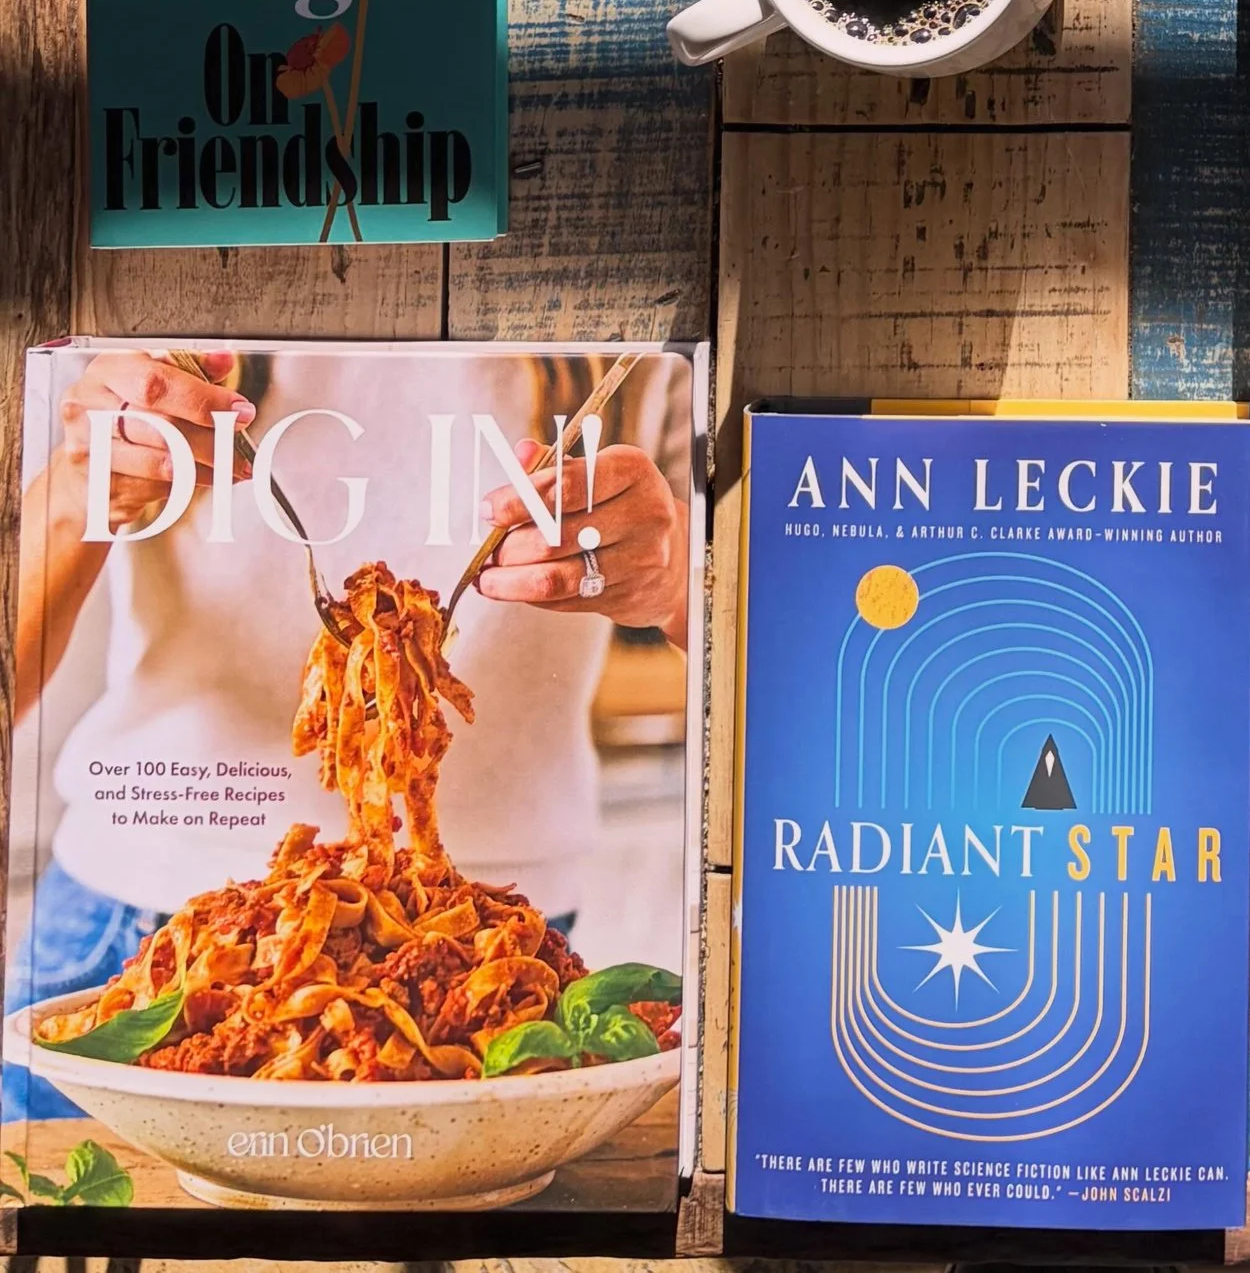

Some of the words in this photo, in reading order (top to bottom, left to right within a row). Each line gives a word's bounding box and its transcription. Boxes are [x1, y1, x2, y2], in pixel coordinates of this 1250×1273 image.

[204, 22, 290, 127] On
[103, 101, 472, 222] Friendship
[80, 409, 370, 547] DIG
[424, 412, 603, 550] IN!
[788, 455, 934, 510] ANN
[974, 458, 1219, 514] LECKIE
[89, 762, 131, 777] Over
[135, 761, 167, 777] 100
[170, 762, 211, 782] Easy,
[216, 762, 293, 780] Delicious,
[94, 786, 126, 801] and
[130, 786, 220, 802] Stress-Free
[224, 787, 286, 805] Recipes
[111, 812, 128, 825] to
[132, 810, 180, 826] Make
[184, 814, 204, 826] on
[209, 811, 266, 829] Repeat
[773, 818, 1044, 877] RADIANT
[1067, 823, 1222, 883] STAR
[808, 1157, 834, 1172] ARE
[839, 1158, 866, 1173] FEW
[871, 1159, 900, 1174] WHO
[906, 1160, 948, 1175] WRITE
[954, 1162, 1011, 1177] SCIENCE
[1017, 1164, 1072, 1179] FICTION
[1077, 1166, 1107, 1180] LIKE
[1112, 1166, 1140, 1181] ANN
[1145, 1166, 1192, 1181] LECKIE
[1197, 1167, 1229, 1181] CAN.
